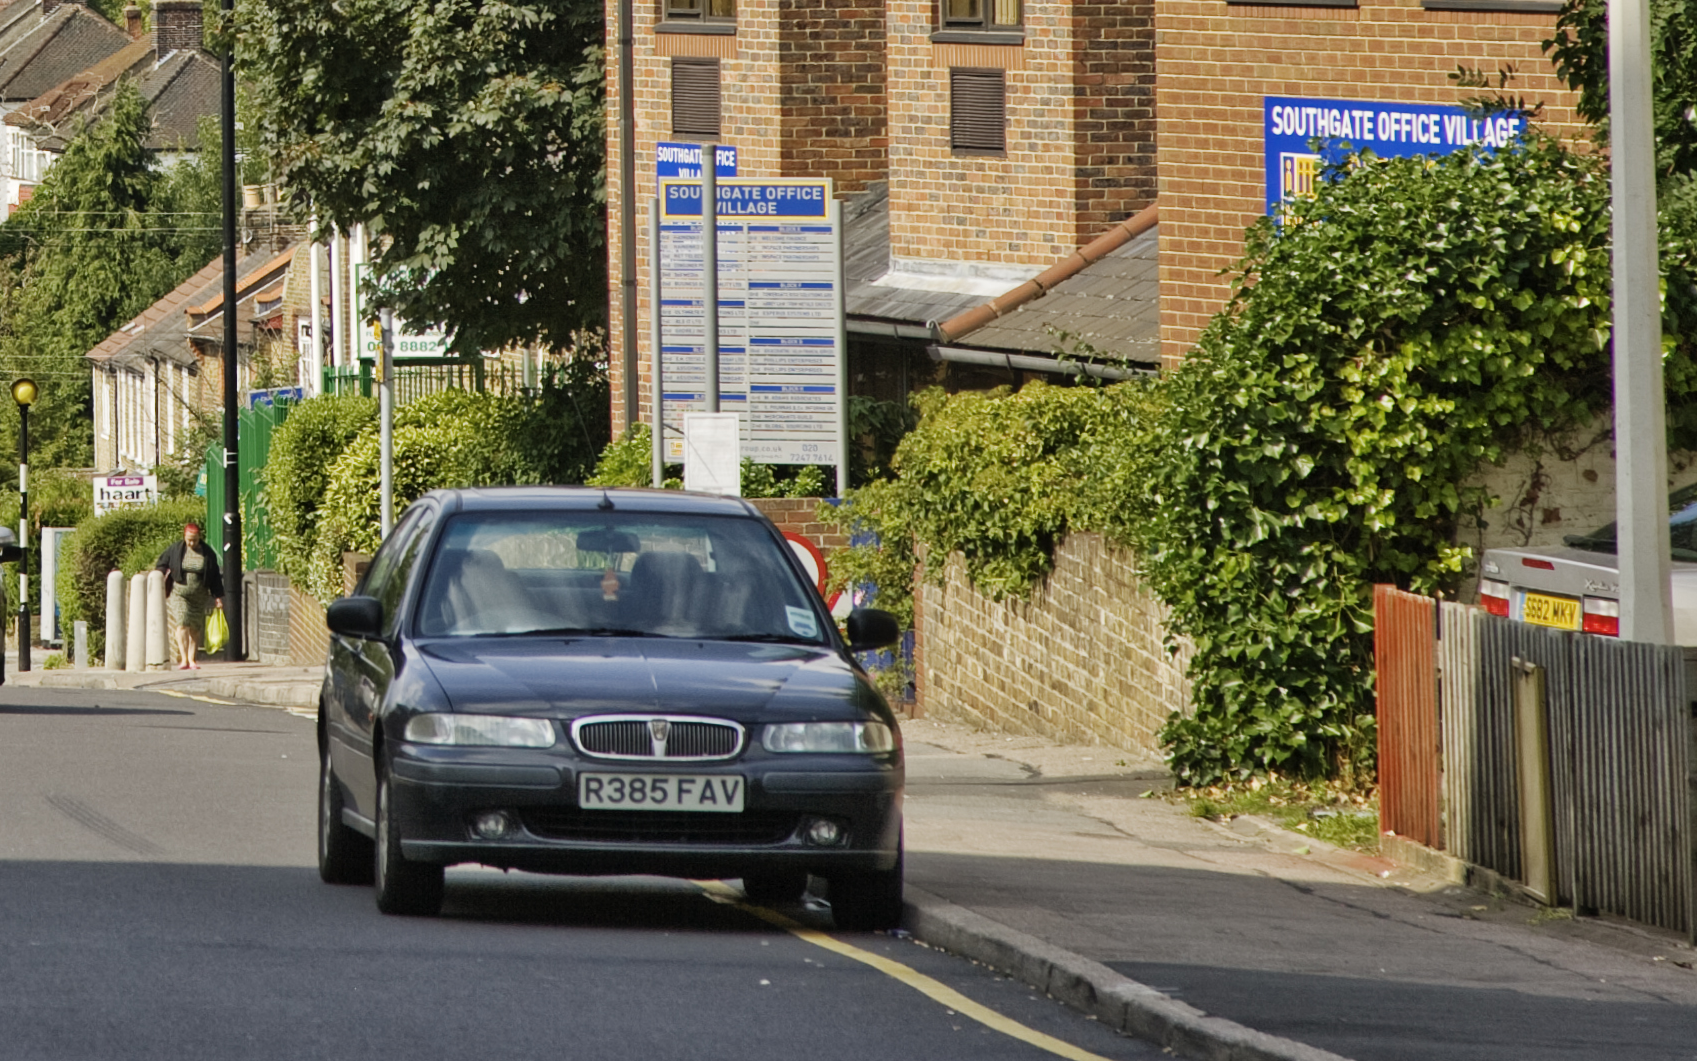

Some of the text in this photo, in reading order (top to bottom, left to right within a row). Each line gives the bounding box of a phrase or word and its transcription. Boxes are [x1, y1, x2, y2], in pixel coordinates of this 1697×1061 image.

[1271, 105, 1520, 148] SOUTHGATE OFFICE VILLAGE
[657, 146, 735, 167] SOUTHGATE FICE
[678, 167, 702, 178] VILLA
[669, 186, 822, 200] SOUGATE OFFICE
[399, 341, 437, 352] 8882
[802, 444, 818, 452] 020
[790, 454, 810, 462] 7247
[813, 454, 834, 462] 7614
[100, 487, 154, 500] haart
[1525, 597, 1577, 625] S682 MKV
[584, 777, 740, 805] R385 FAV
